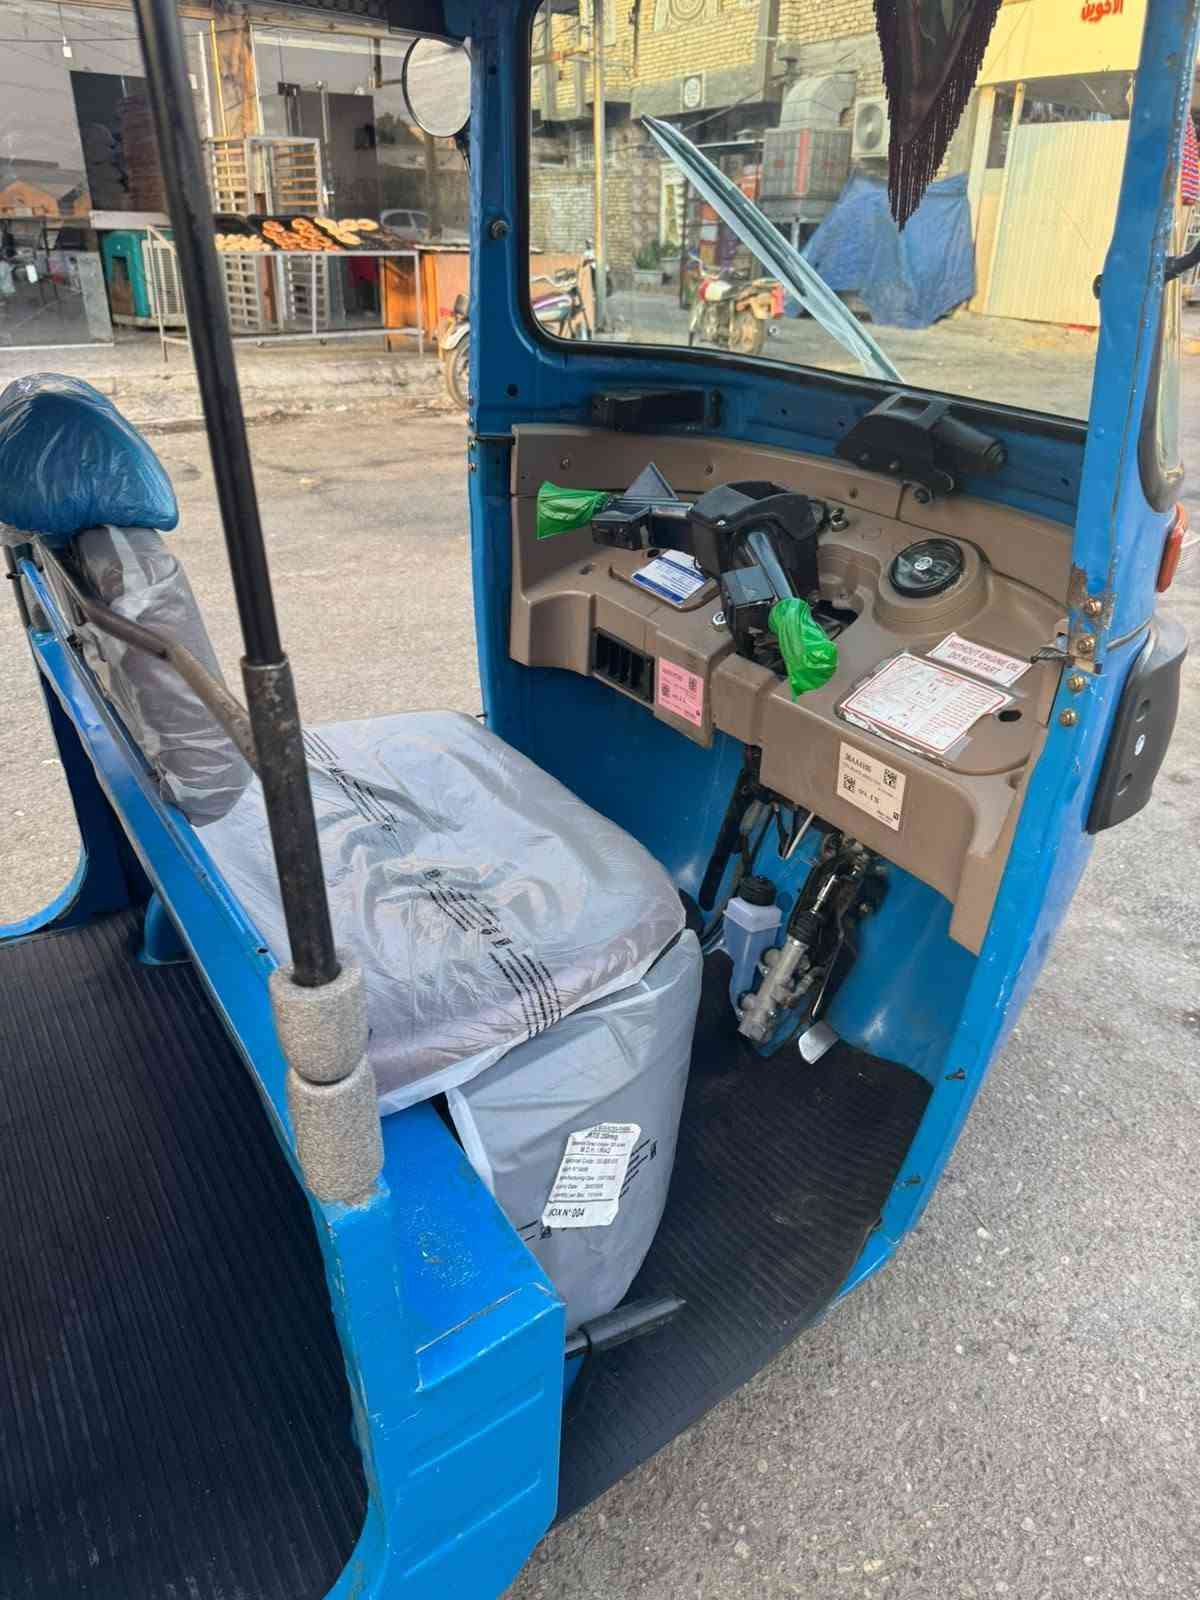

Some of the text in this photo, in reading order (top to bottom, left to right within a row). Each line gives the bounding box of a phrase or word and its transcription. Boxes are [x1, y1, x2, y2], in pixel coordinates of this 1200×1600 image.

[948, 640, 980, 656] WITHOUT
[979, 651, 1006, 667] ENGINE
[948, 651, 1002, 674] DO NOT START
